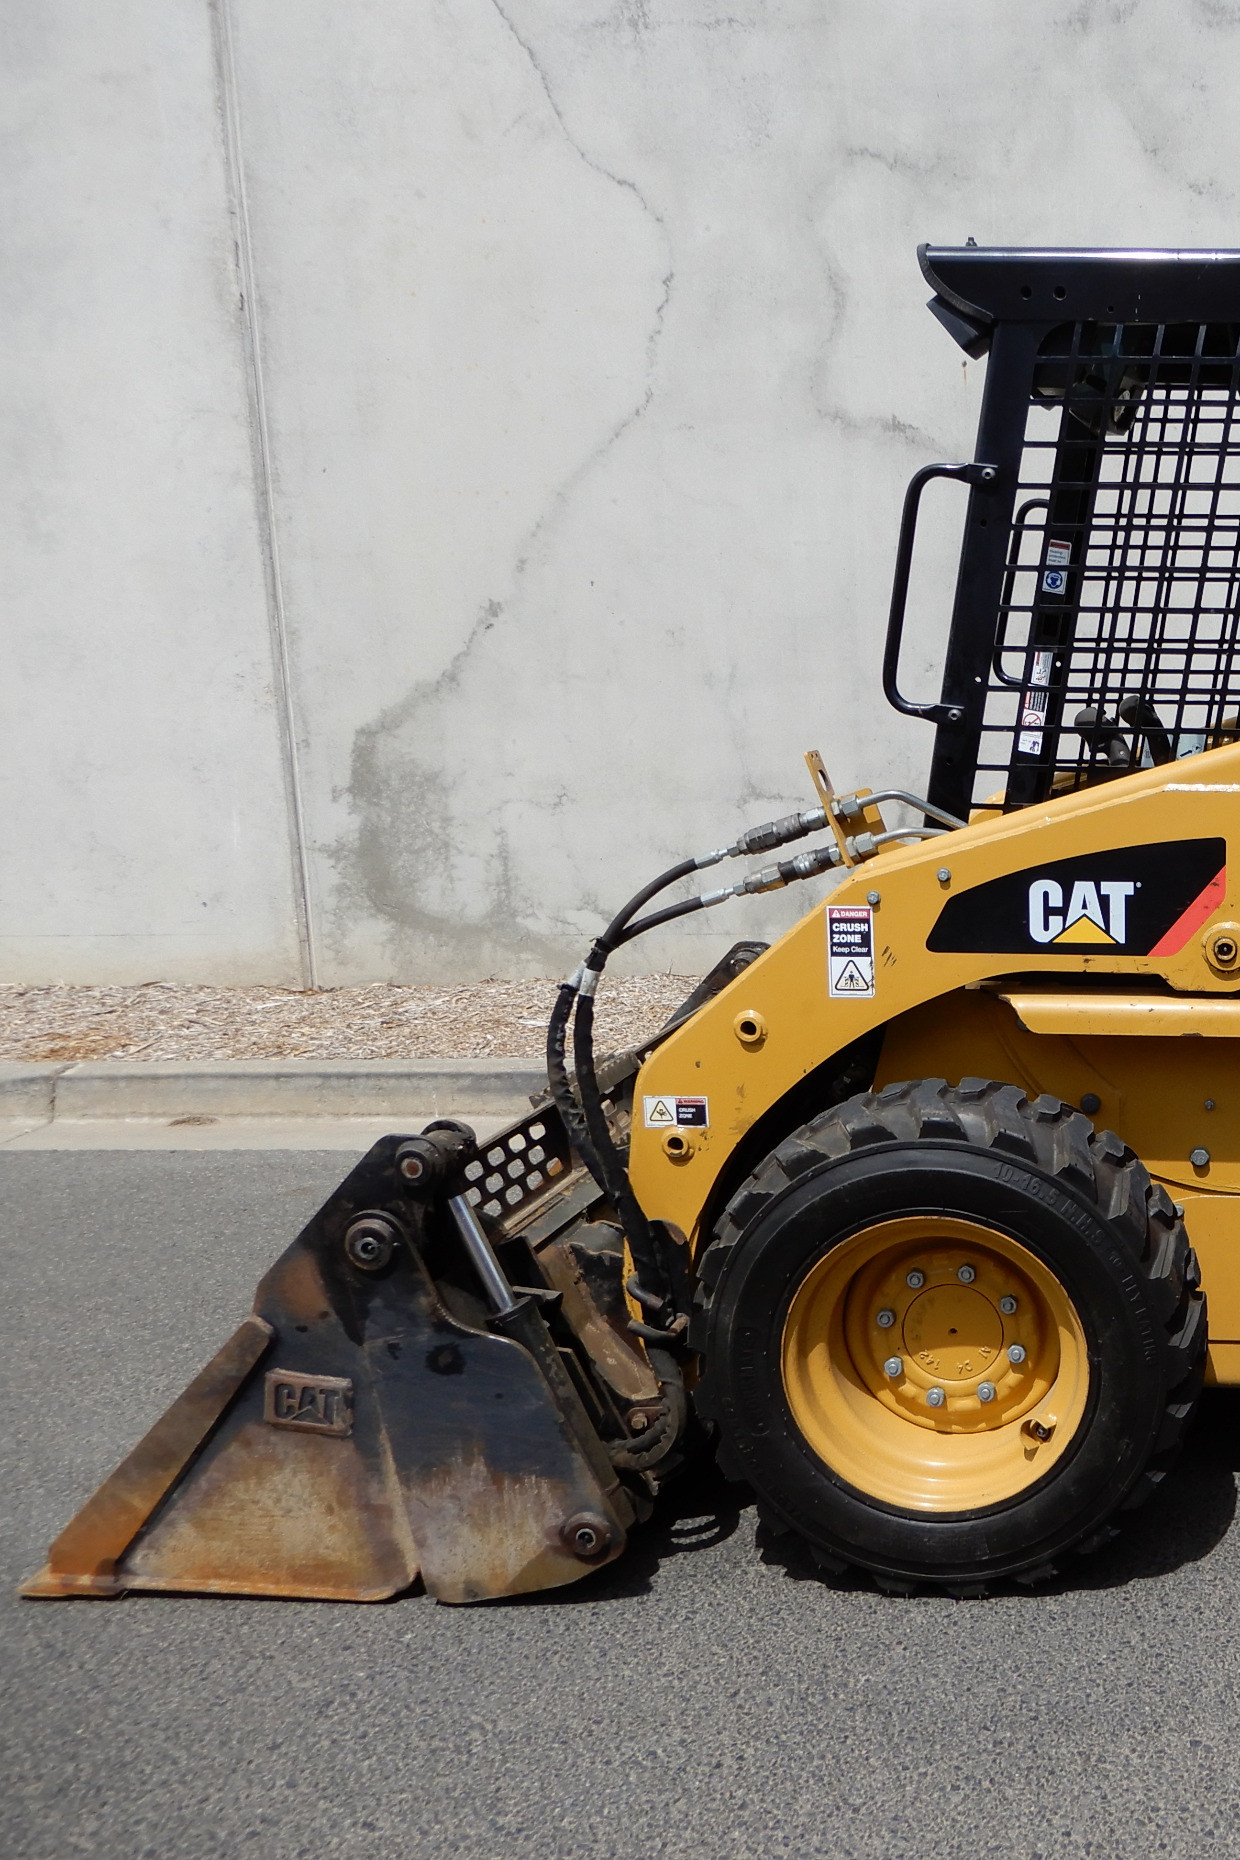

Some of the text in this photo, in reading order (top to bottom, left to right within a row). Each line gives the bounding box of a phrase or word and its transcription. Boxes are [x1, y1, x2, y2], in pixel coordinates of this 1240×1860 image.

[832, 922, 868, 932] CRUSH
[1028, 879, 1135, 944] CAT
[832, 934, 862, 943] ZONE
[994, 1162, 1060, 1206] 10-16.5
[274, 1383, 341, 1426] CAT
